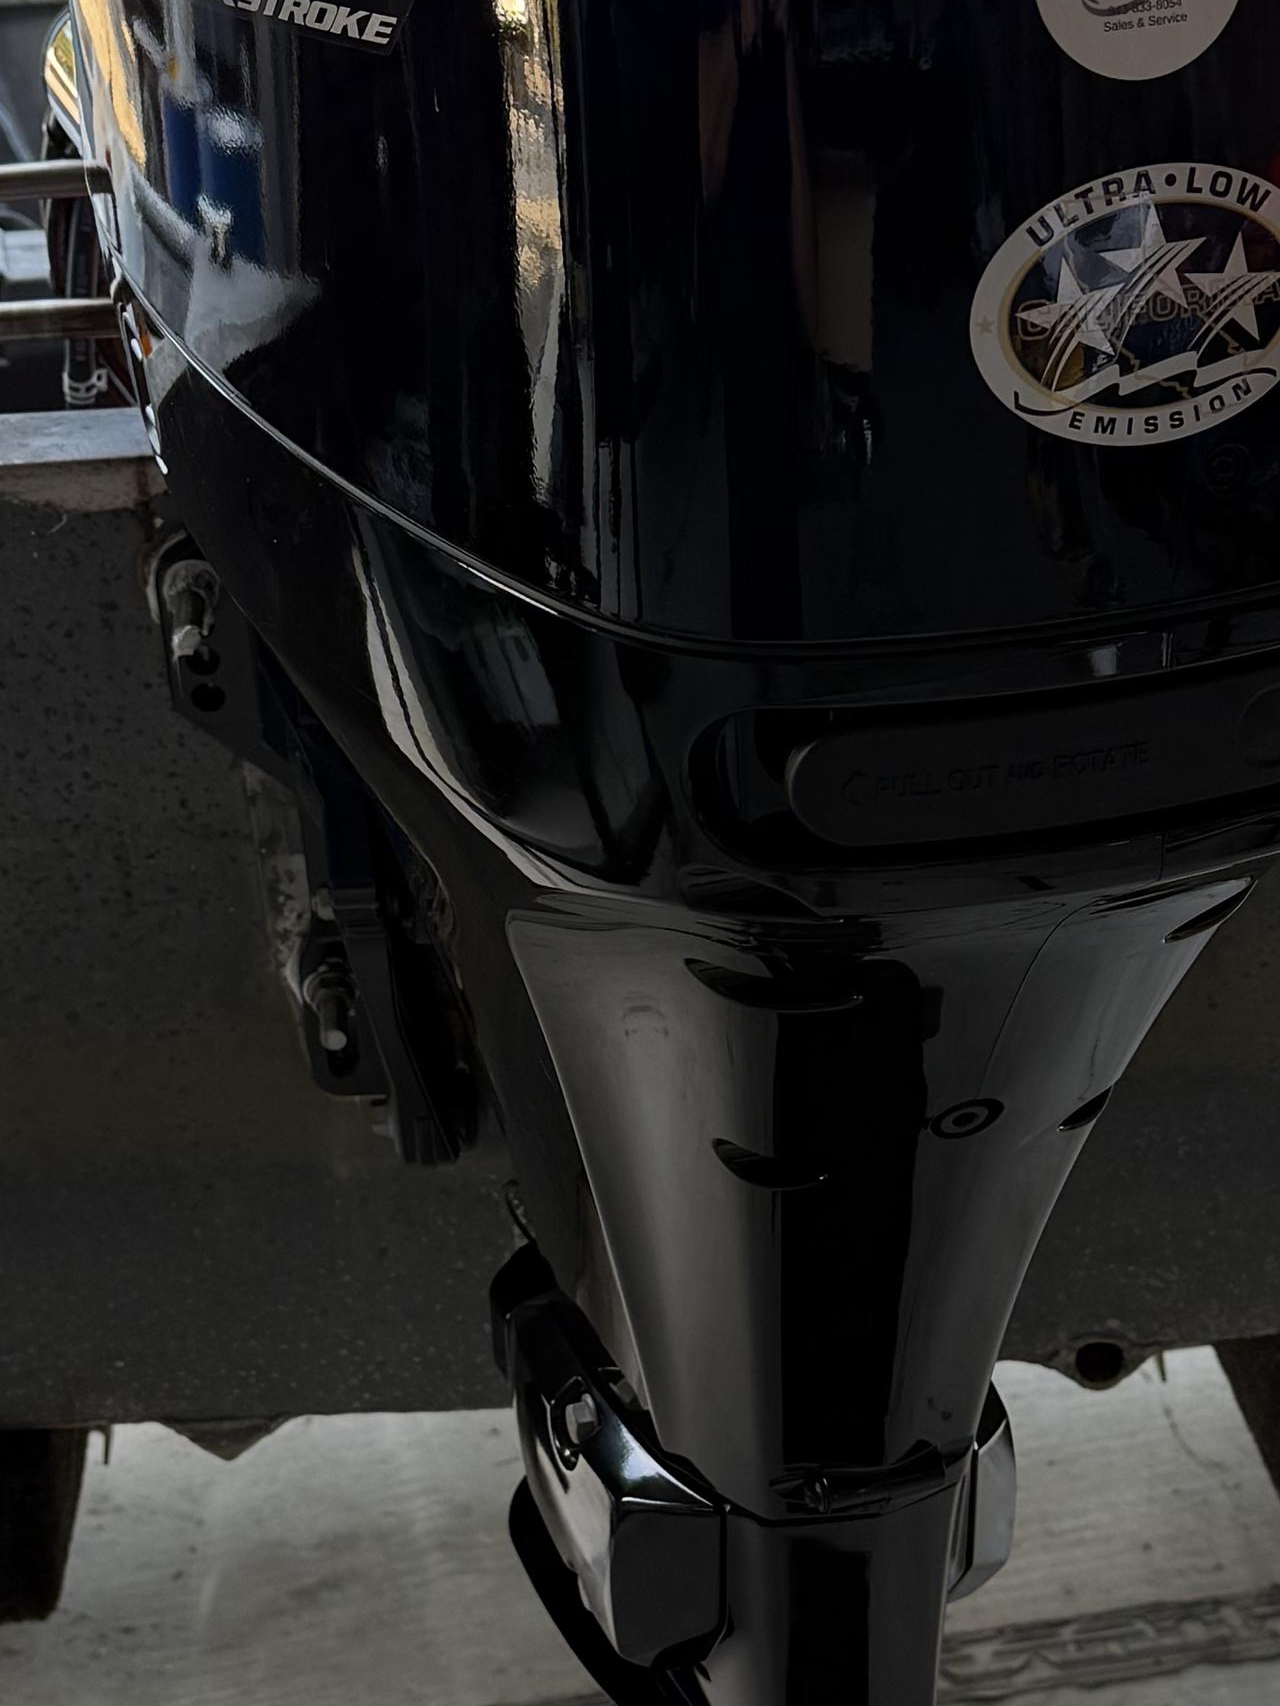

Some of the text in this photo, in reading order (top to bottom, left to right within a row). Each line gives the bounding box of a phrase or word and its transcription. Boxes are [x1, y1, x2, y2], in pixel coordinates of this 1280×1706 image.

[1103, 11, 1188, 33] Sales & Service
[1026, 166, 1271, 247] ULTRA LOW
[1069, 378, 1253, 435] EMISSION
